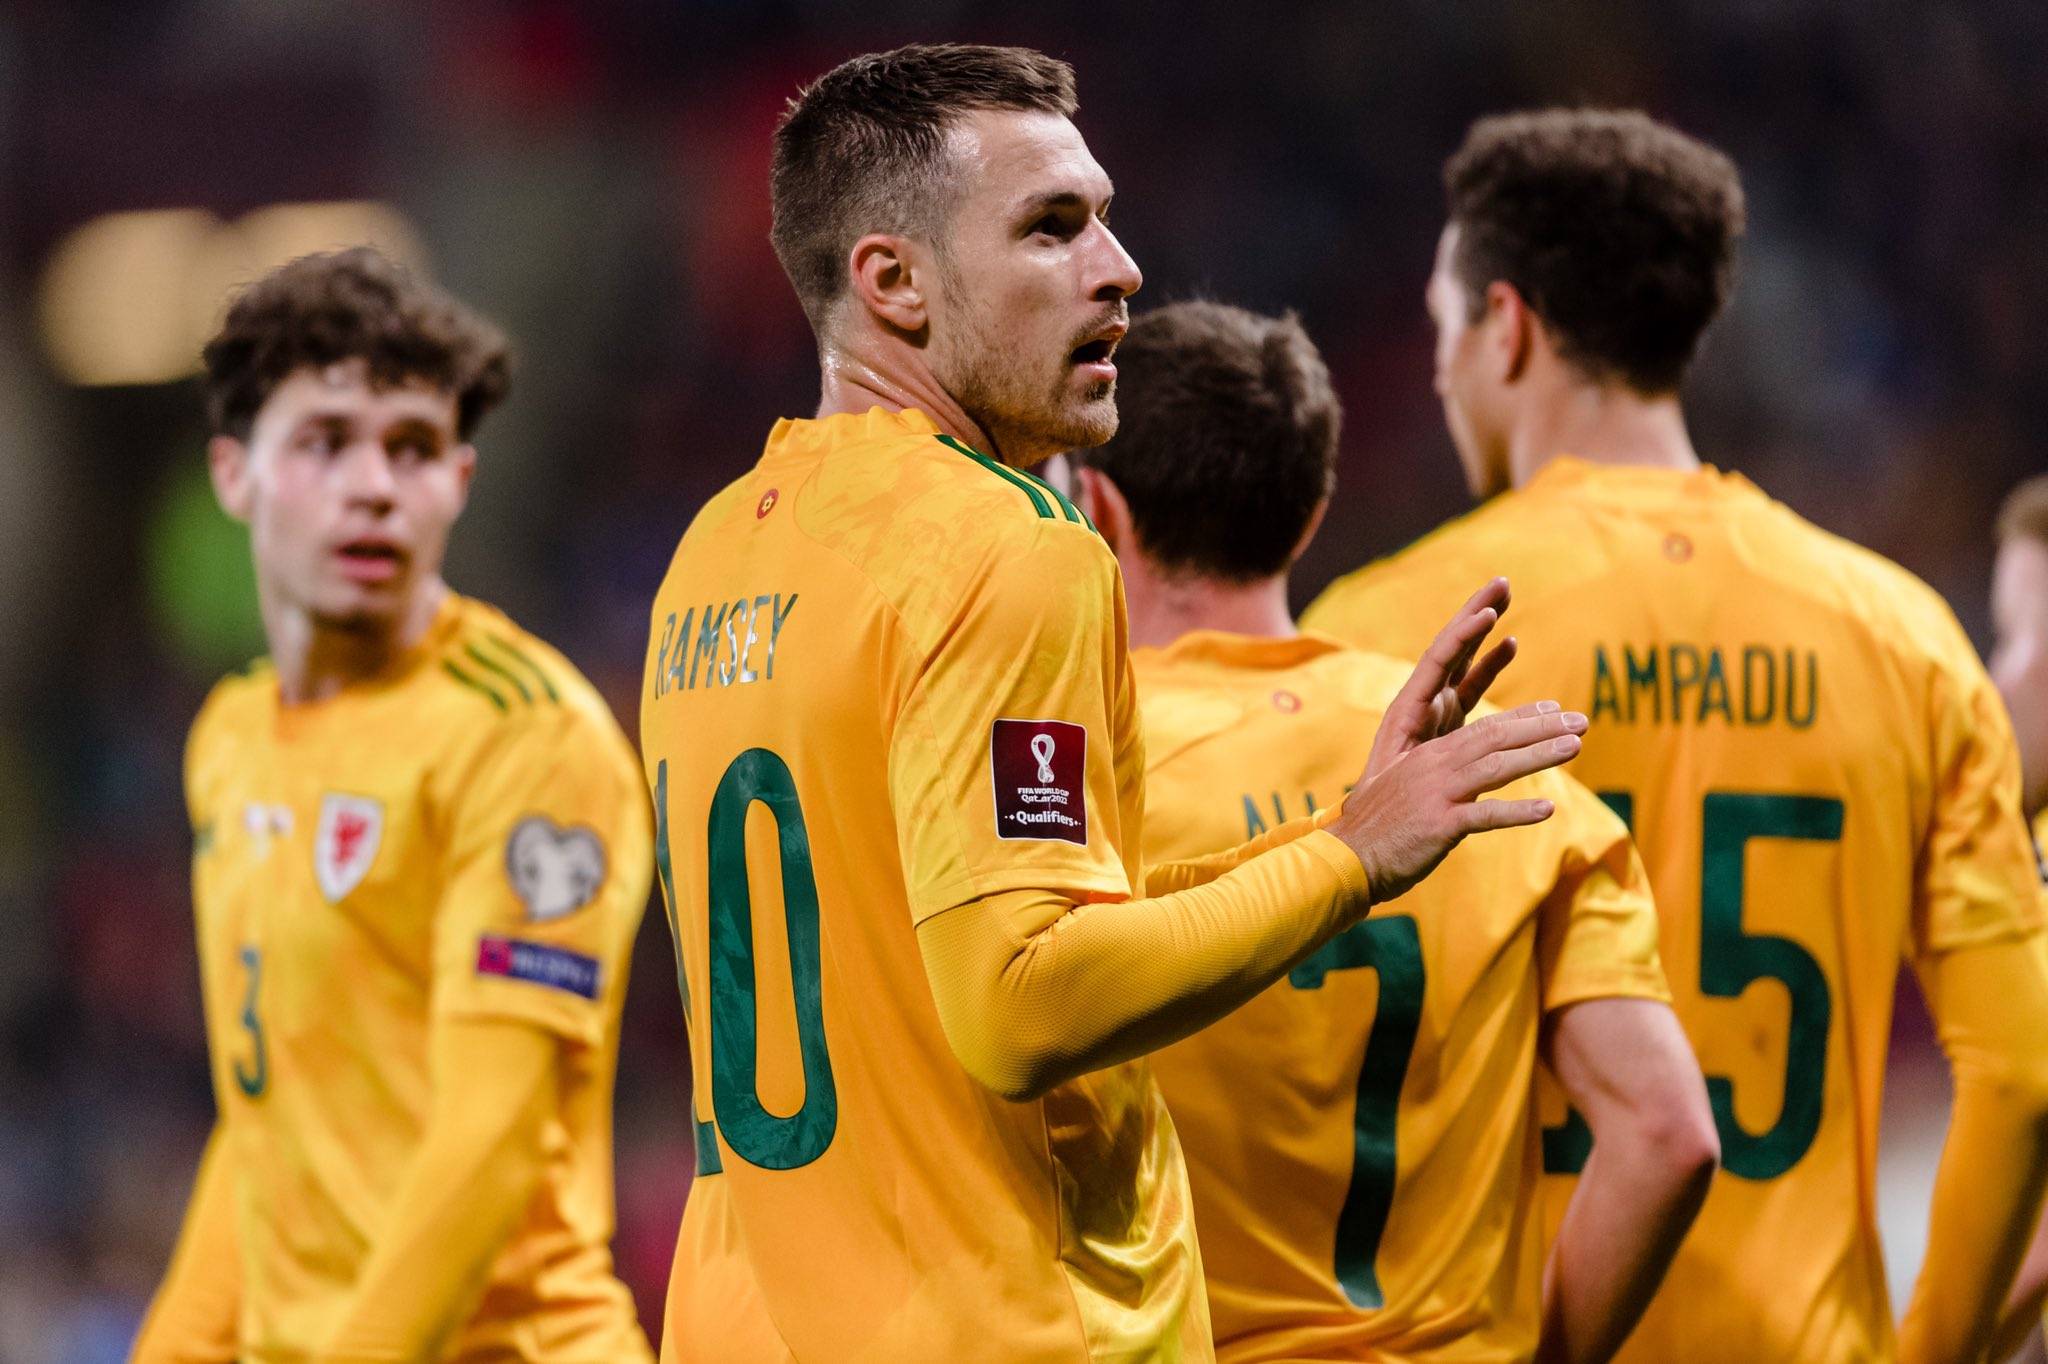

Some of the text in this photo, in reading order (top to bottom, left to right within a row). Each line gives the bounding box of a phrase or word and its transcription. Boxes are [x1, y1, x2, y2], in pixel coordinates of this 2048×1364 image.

[656, 593, 799, 700] RAMSEY
[1590, 643, 1819, 729] AMPADU
[1016, 810, 1074, 826] Qualifiers
[1017, 787, 1034, 795] FIFA
[233, 944, 269, 1098] 3
[1289, 913, 1426, 1310] 7
